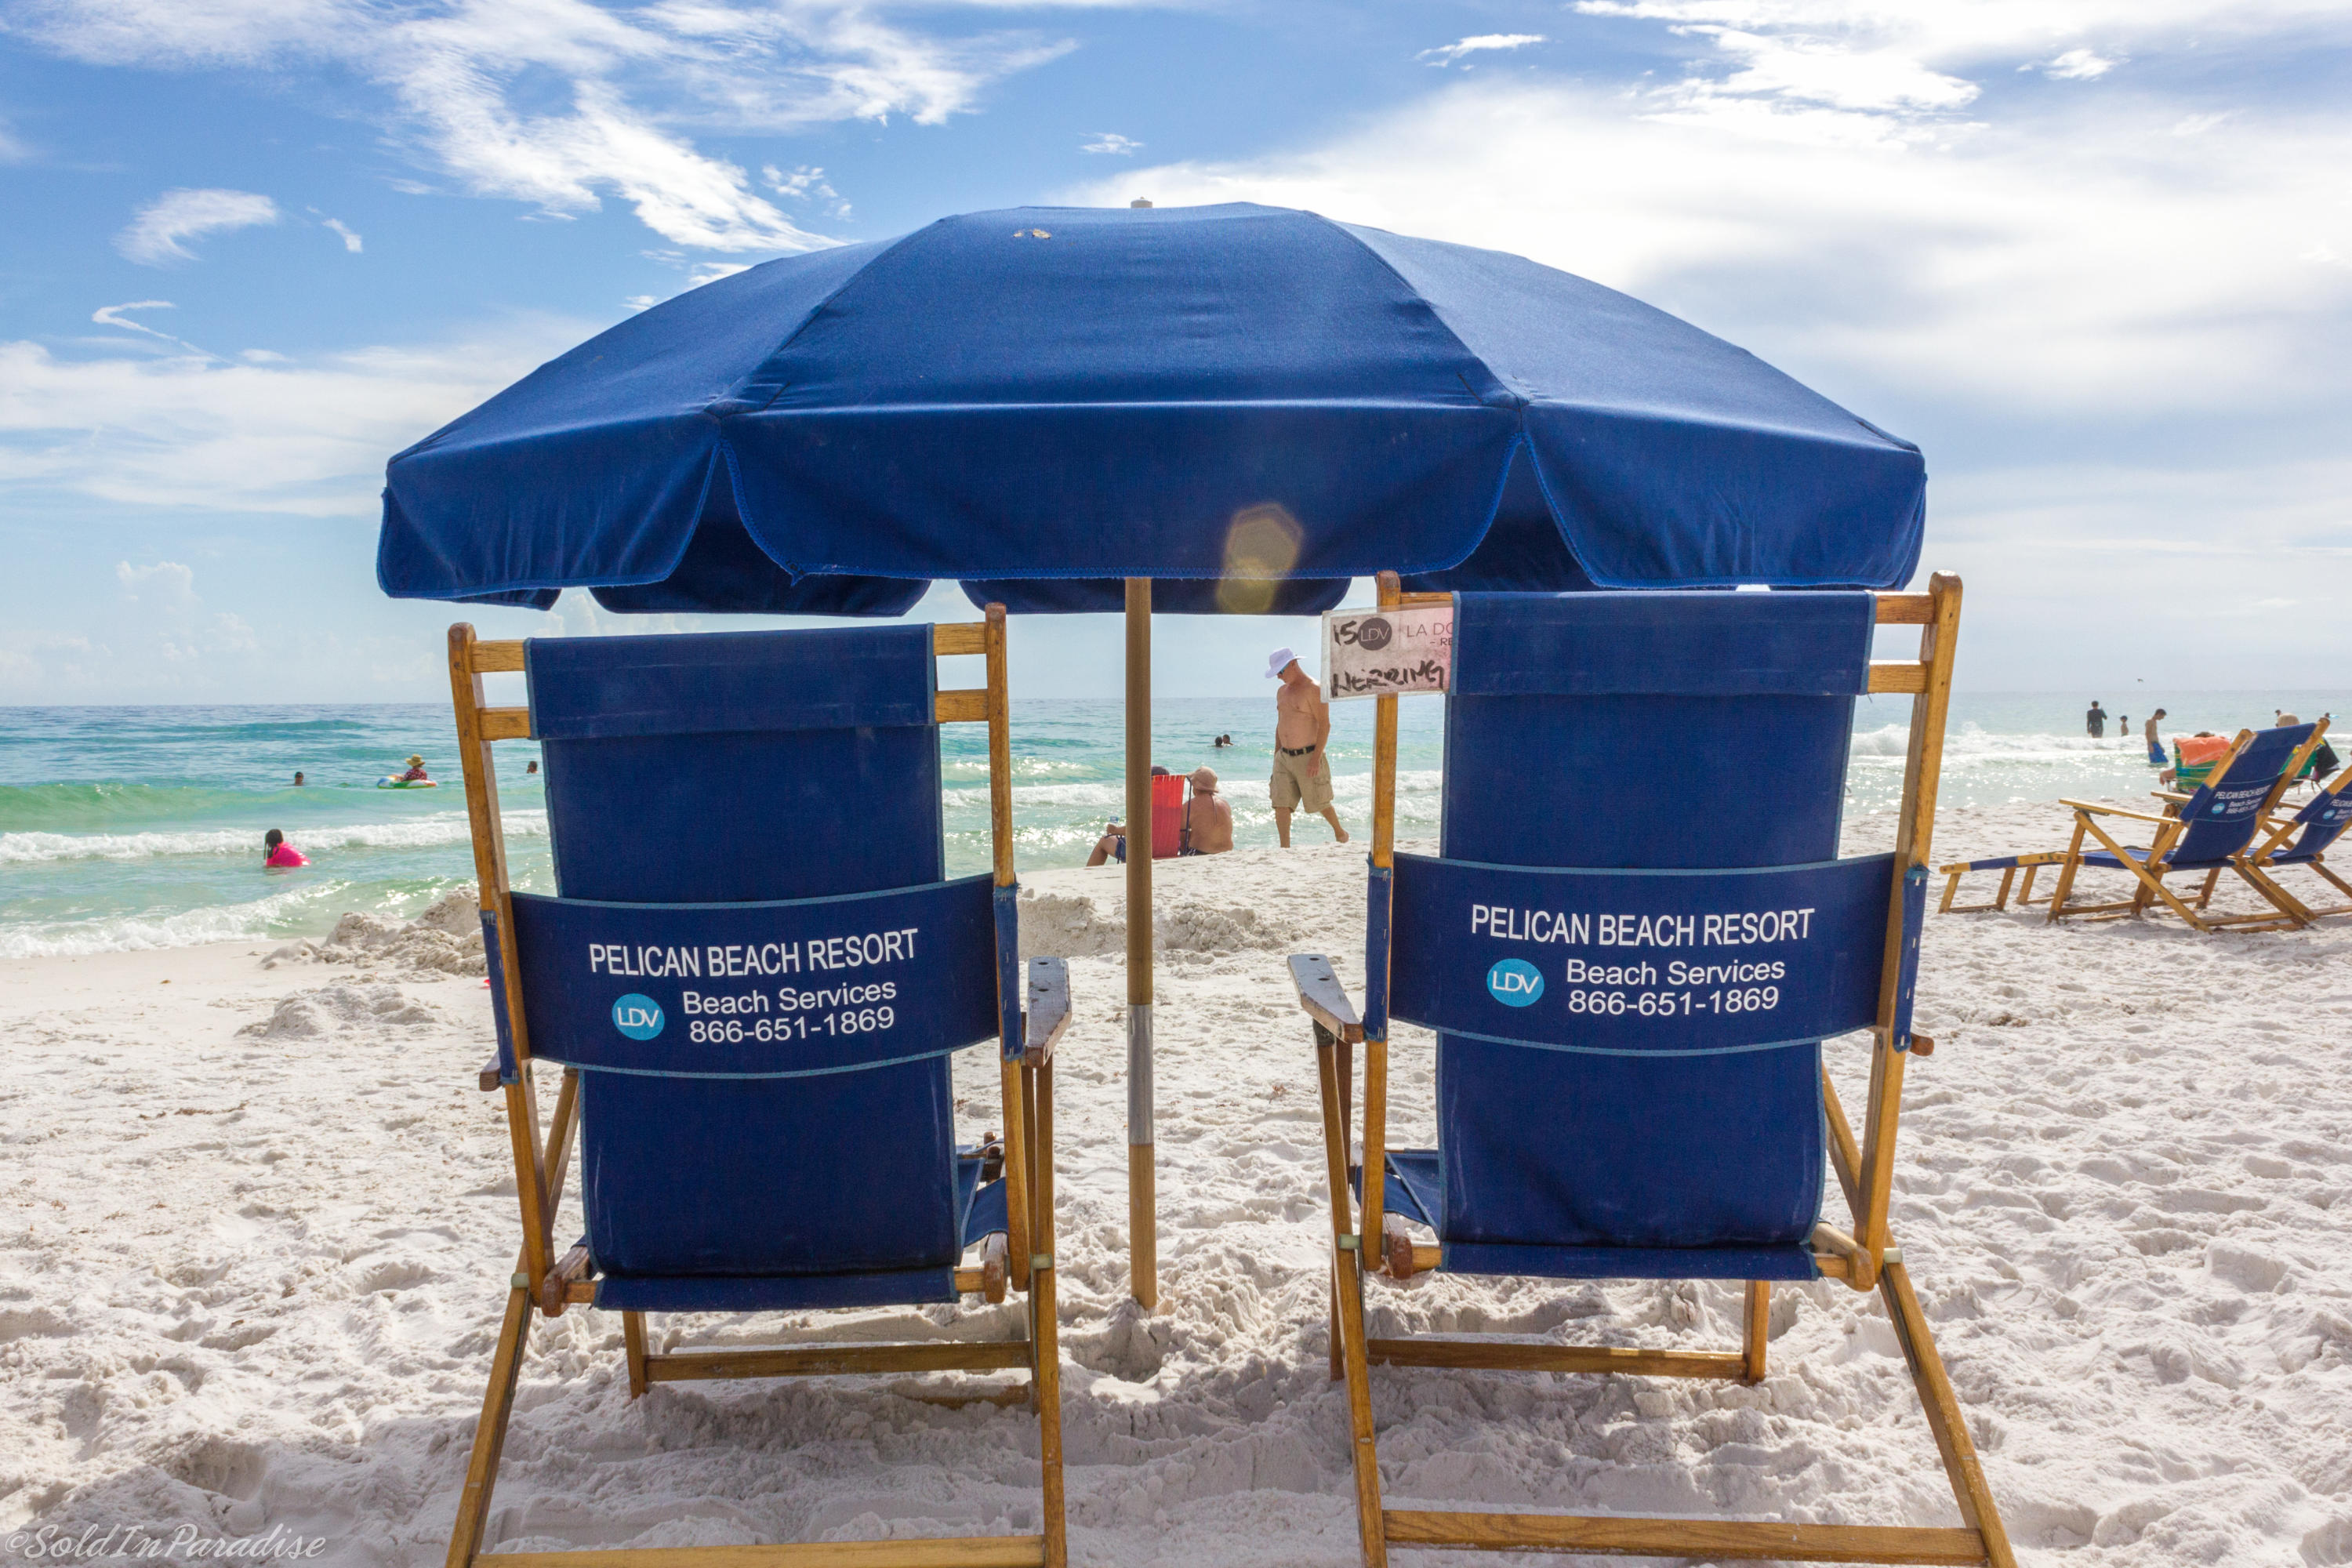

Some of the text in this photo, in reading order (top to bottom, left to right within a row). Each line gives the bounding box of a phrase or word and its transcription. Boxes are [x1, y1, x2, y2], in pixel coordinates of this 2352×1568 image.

[1360, 626, 1390, 642] LDV
[1406, 623, 1428, 637] LA
[1472, 904, 1816, 947] PELICAN BEACH RESORT
[589, 927, 918, 977] PELICAN BEACH RESORT
[1492, 971, 1540, 994] LDV
[1566, 958, 1786, 985] Beach Services
[683, 981, 897, 1014] Beach Services
[1568, 985, 1779, 1016] 866-651-1869
[617, 1007, 659, 1028] LDV
[690, 1006, 895, 1043] 866-651-1869
